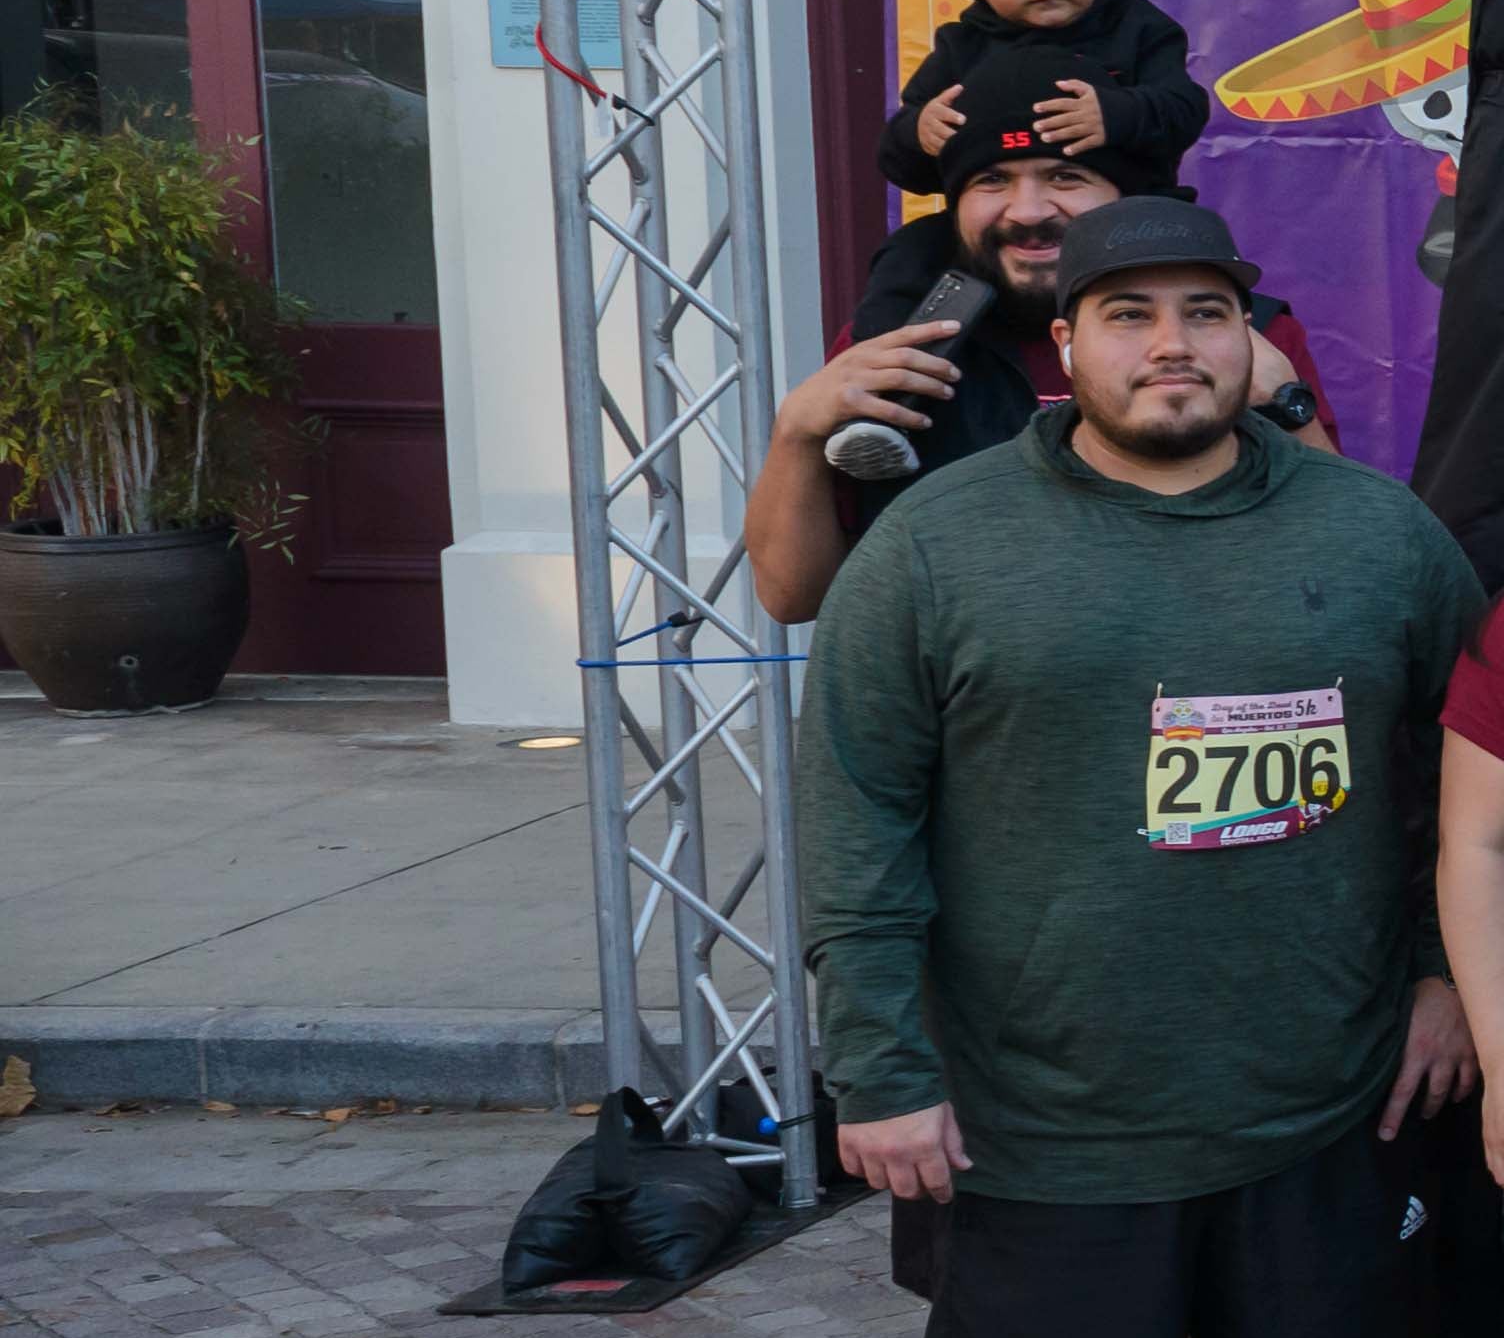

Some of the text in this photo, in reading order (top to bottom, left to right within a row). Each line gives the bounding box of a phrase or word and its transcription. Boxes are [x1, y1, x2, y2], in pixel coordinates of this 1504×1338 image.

[1227, 710, 1293, 722] MUERTOS
[1295, 698, 1317, 717] 5k
[1155, 737, 1341, 814] 2706
[1220, 820, 1288, 839] LONGO
